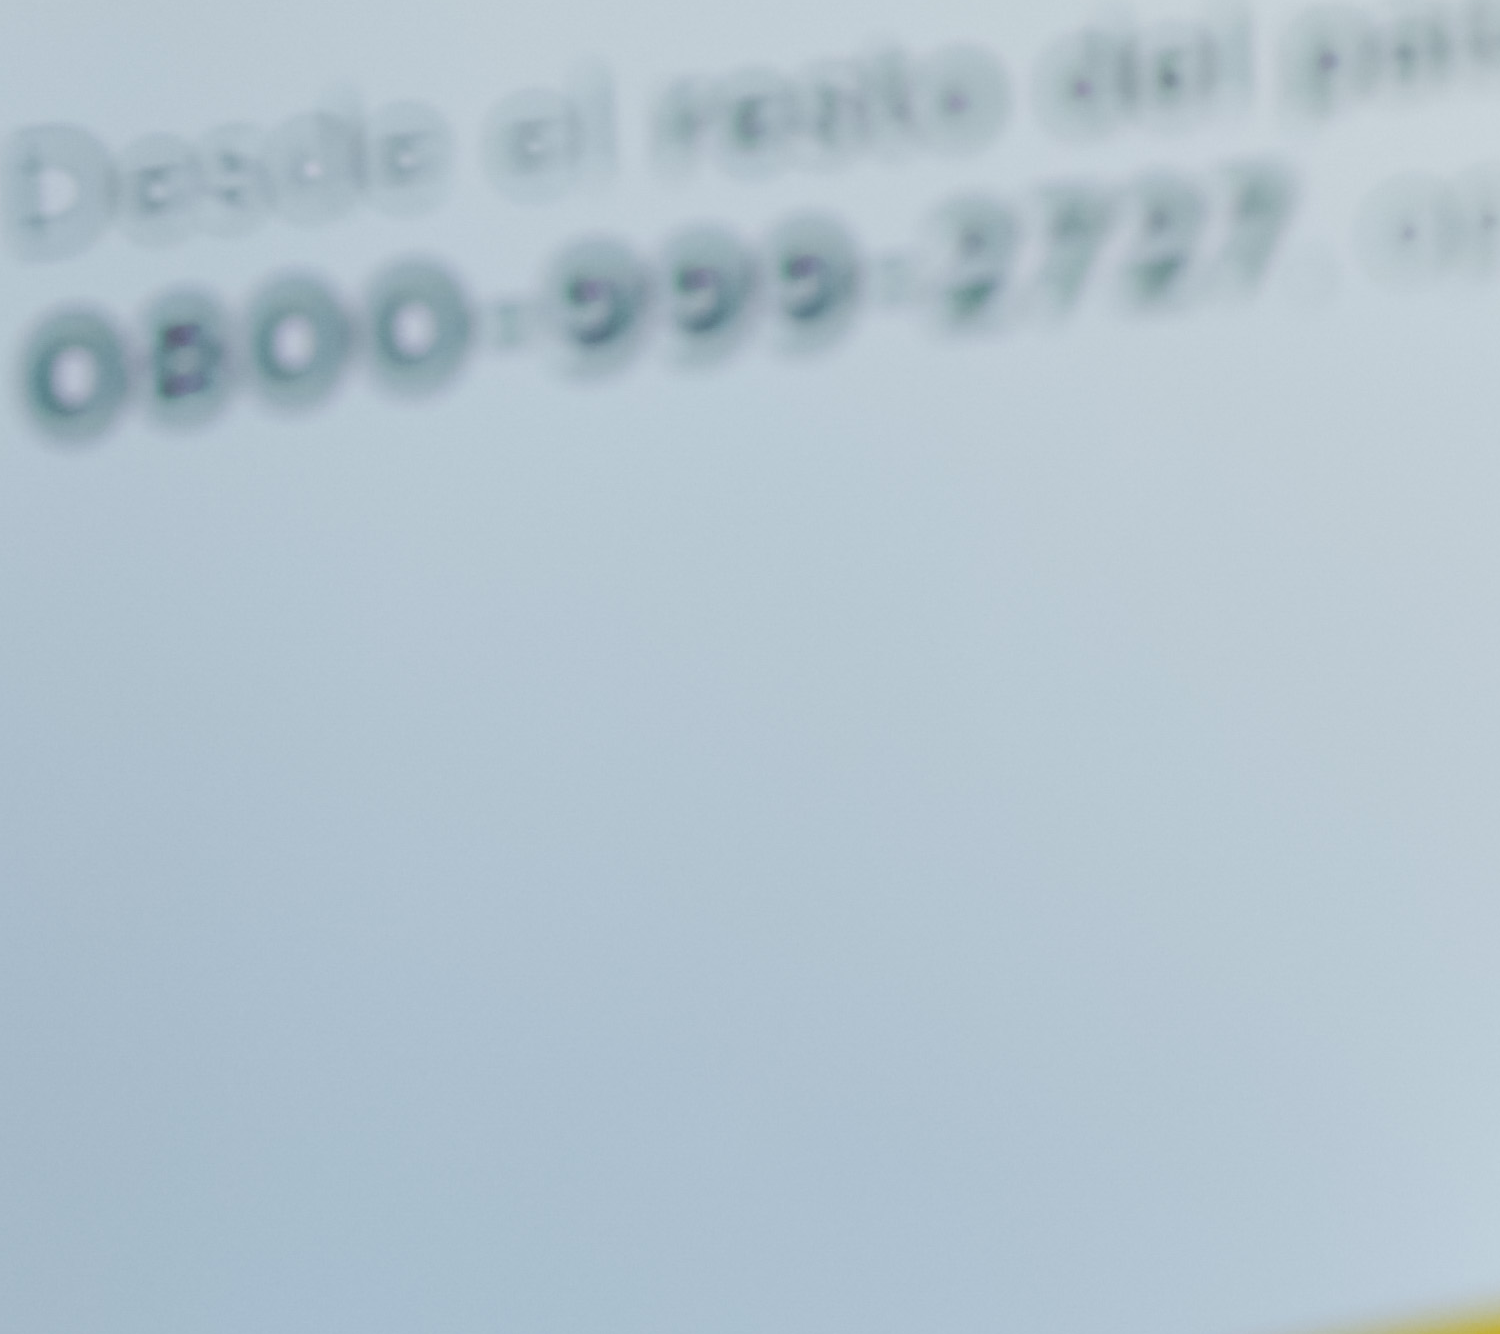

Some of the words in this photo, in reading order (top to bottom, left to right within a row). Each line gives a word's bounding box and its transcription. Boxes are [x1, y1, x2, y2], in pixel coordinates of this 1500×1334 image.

[0, 89, 450, 259] Desde
[487, 69, 610, 193] el
[652, 45, 994, 173] resto
[1043, 10, 1249, 132] del
